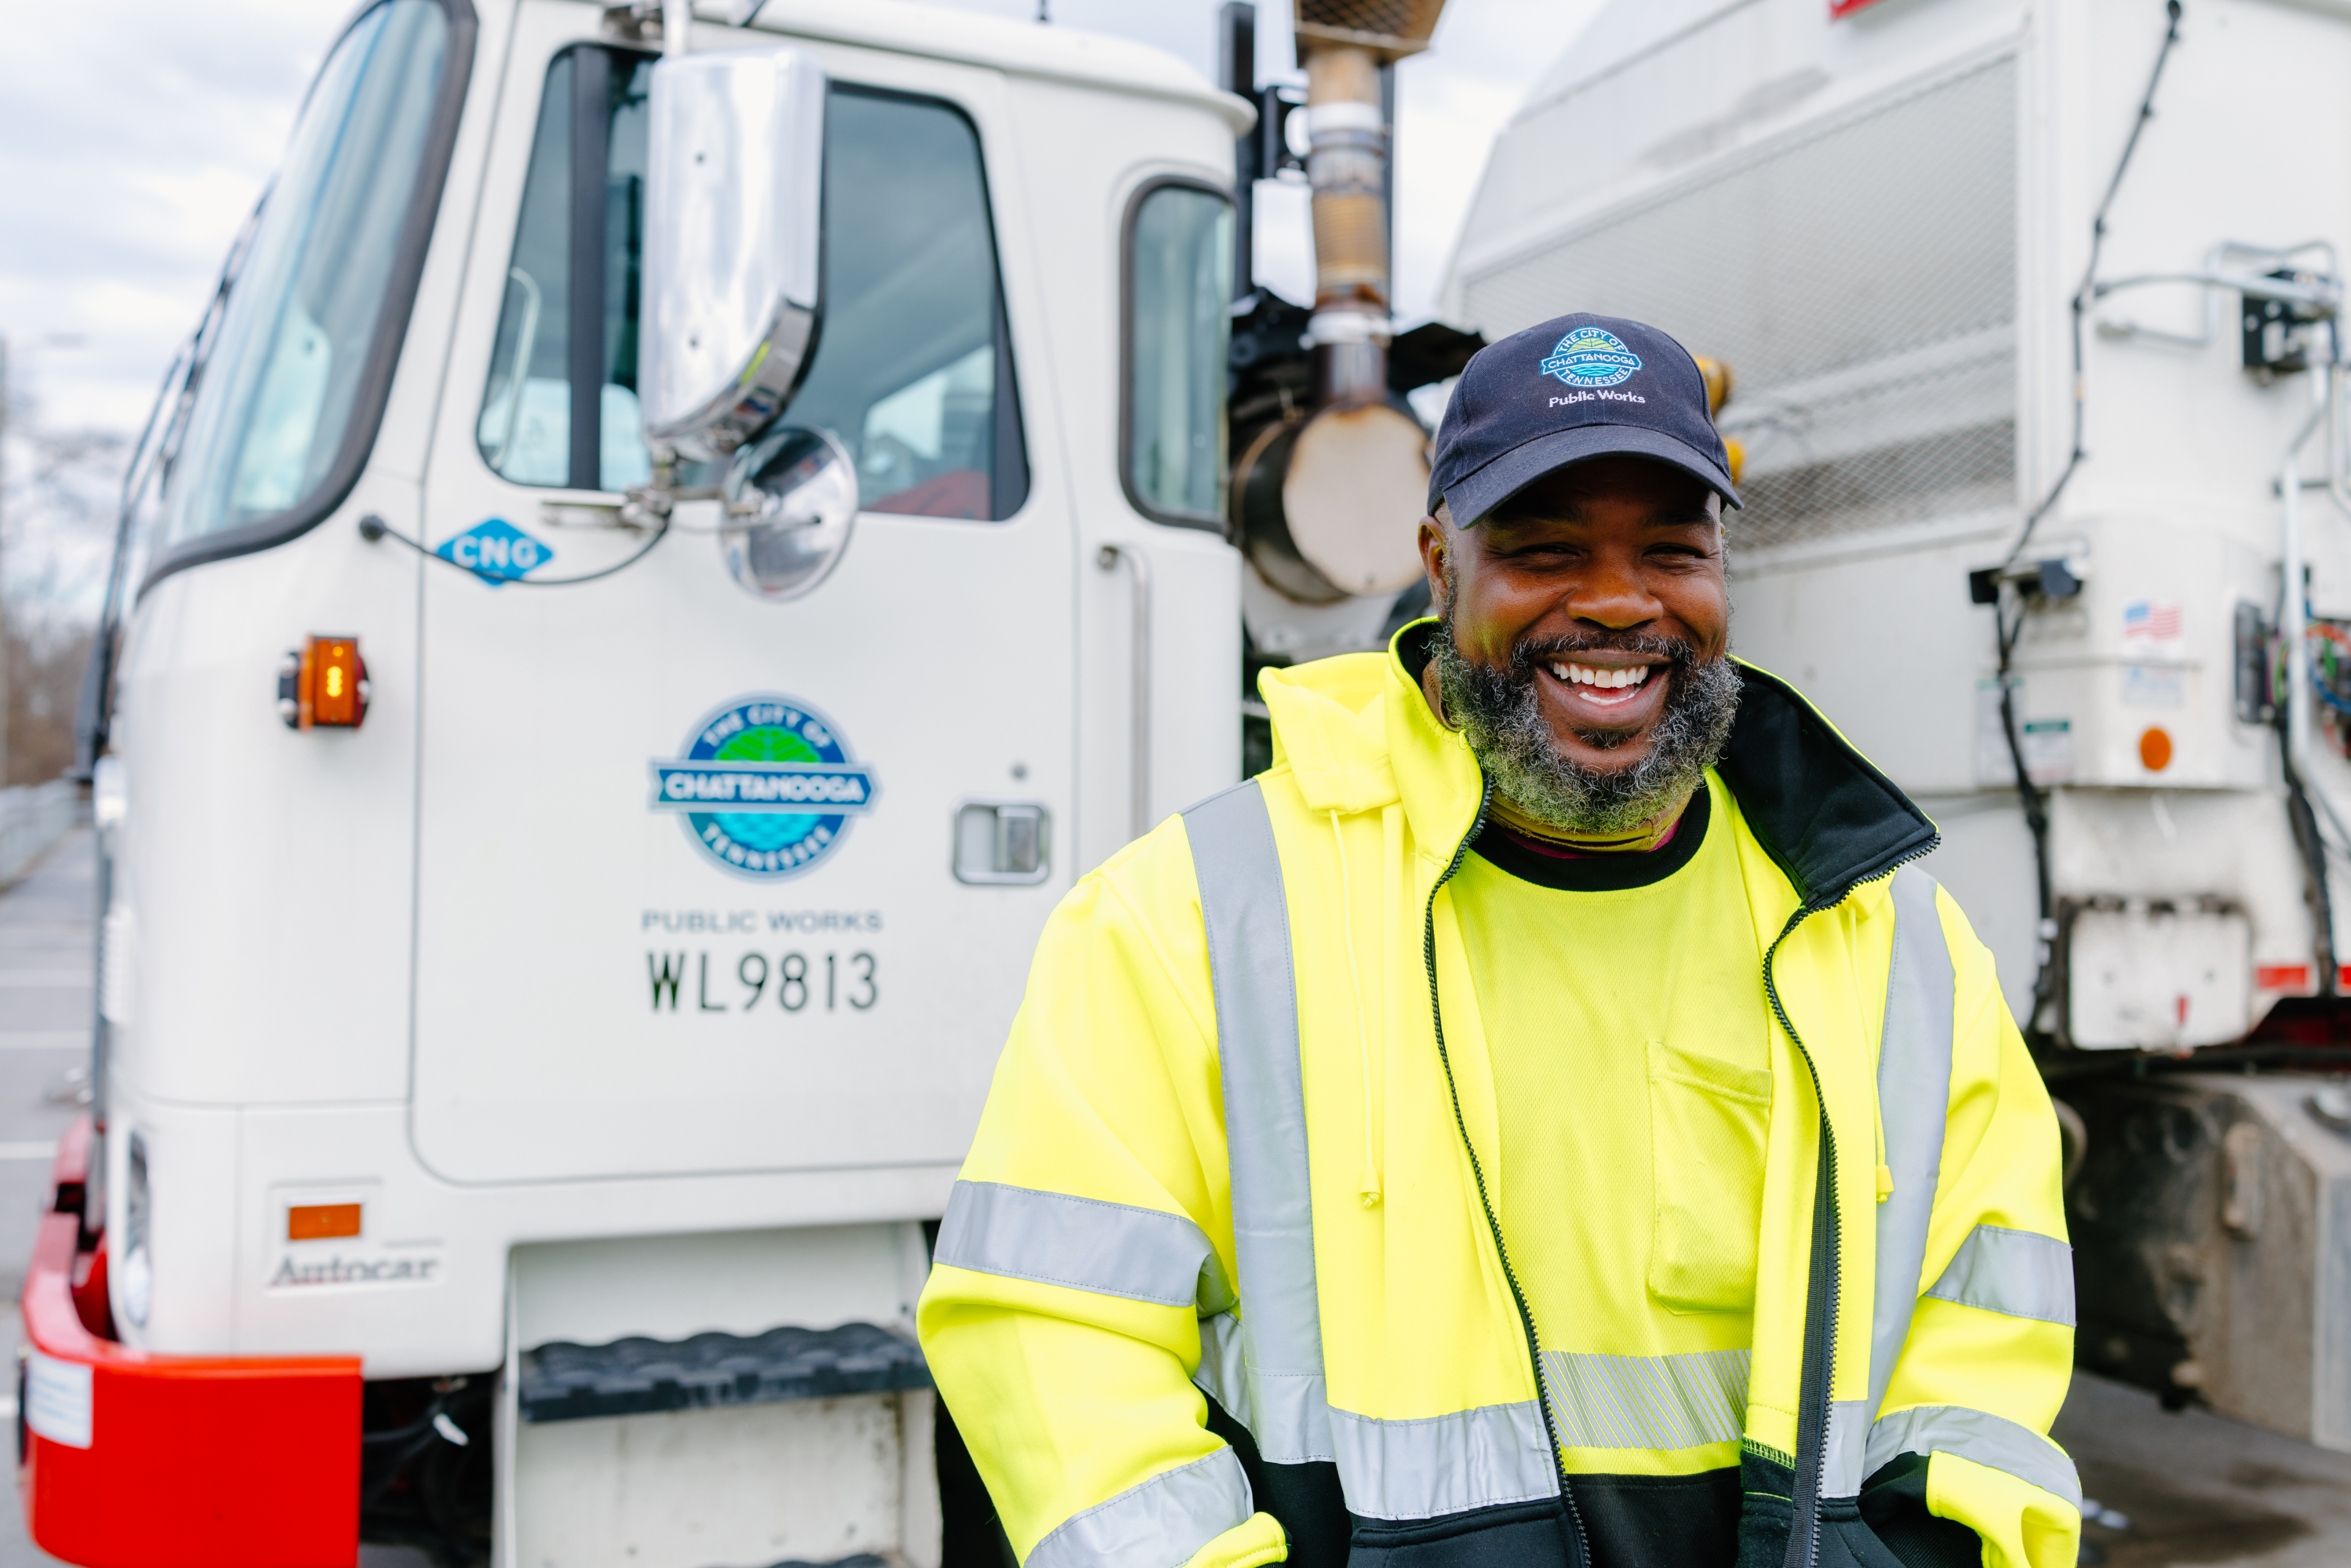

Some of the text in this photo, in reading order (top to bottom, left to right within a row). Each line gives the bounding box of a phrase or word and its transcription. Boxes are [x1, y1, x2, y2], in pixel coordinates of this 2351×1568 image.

[1559, 329, 1625, 352] THE CITY OF
[1548, 353, 1636, 369] CHATTANOOGA
[1561, 367, 1628, 385] TENNESSEE
[1549, 389, 1646, 408] Public Works
[453, 535, 538, 568] CNG
[703, 703, 831, 748] THE CITY OF
[665, 772, 864, 801] CHATTANOOGA
[703, 823, 832, 871] TENNESSEE
[642, 910, 882, 933] PUBLIC WORKS
[647, 950, 878, 1013] WL9813
[269, 1255, 438, 1286] Autocar
